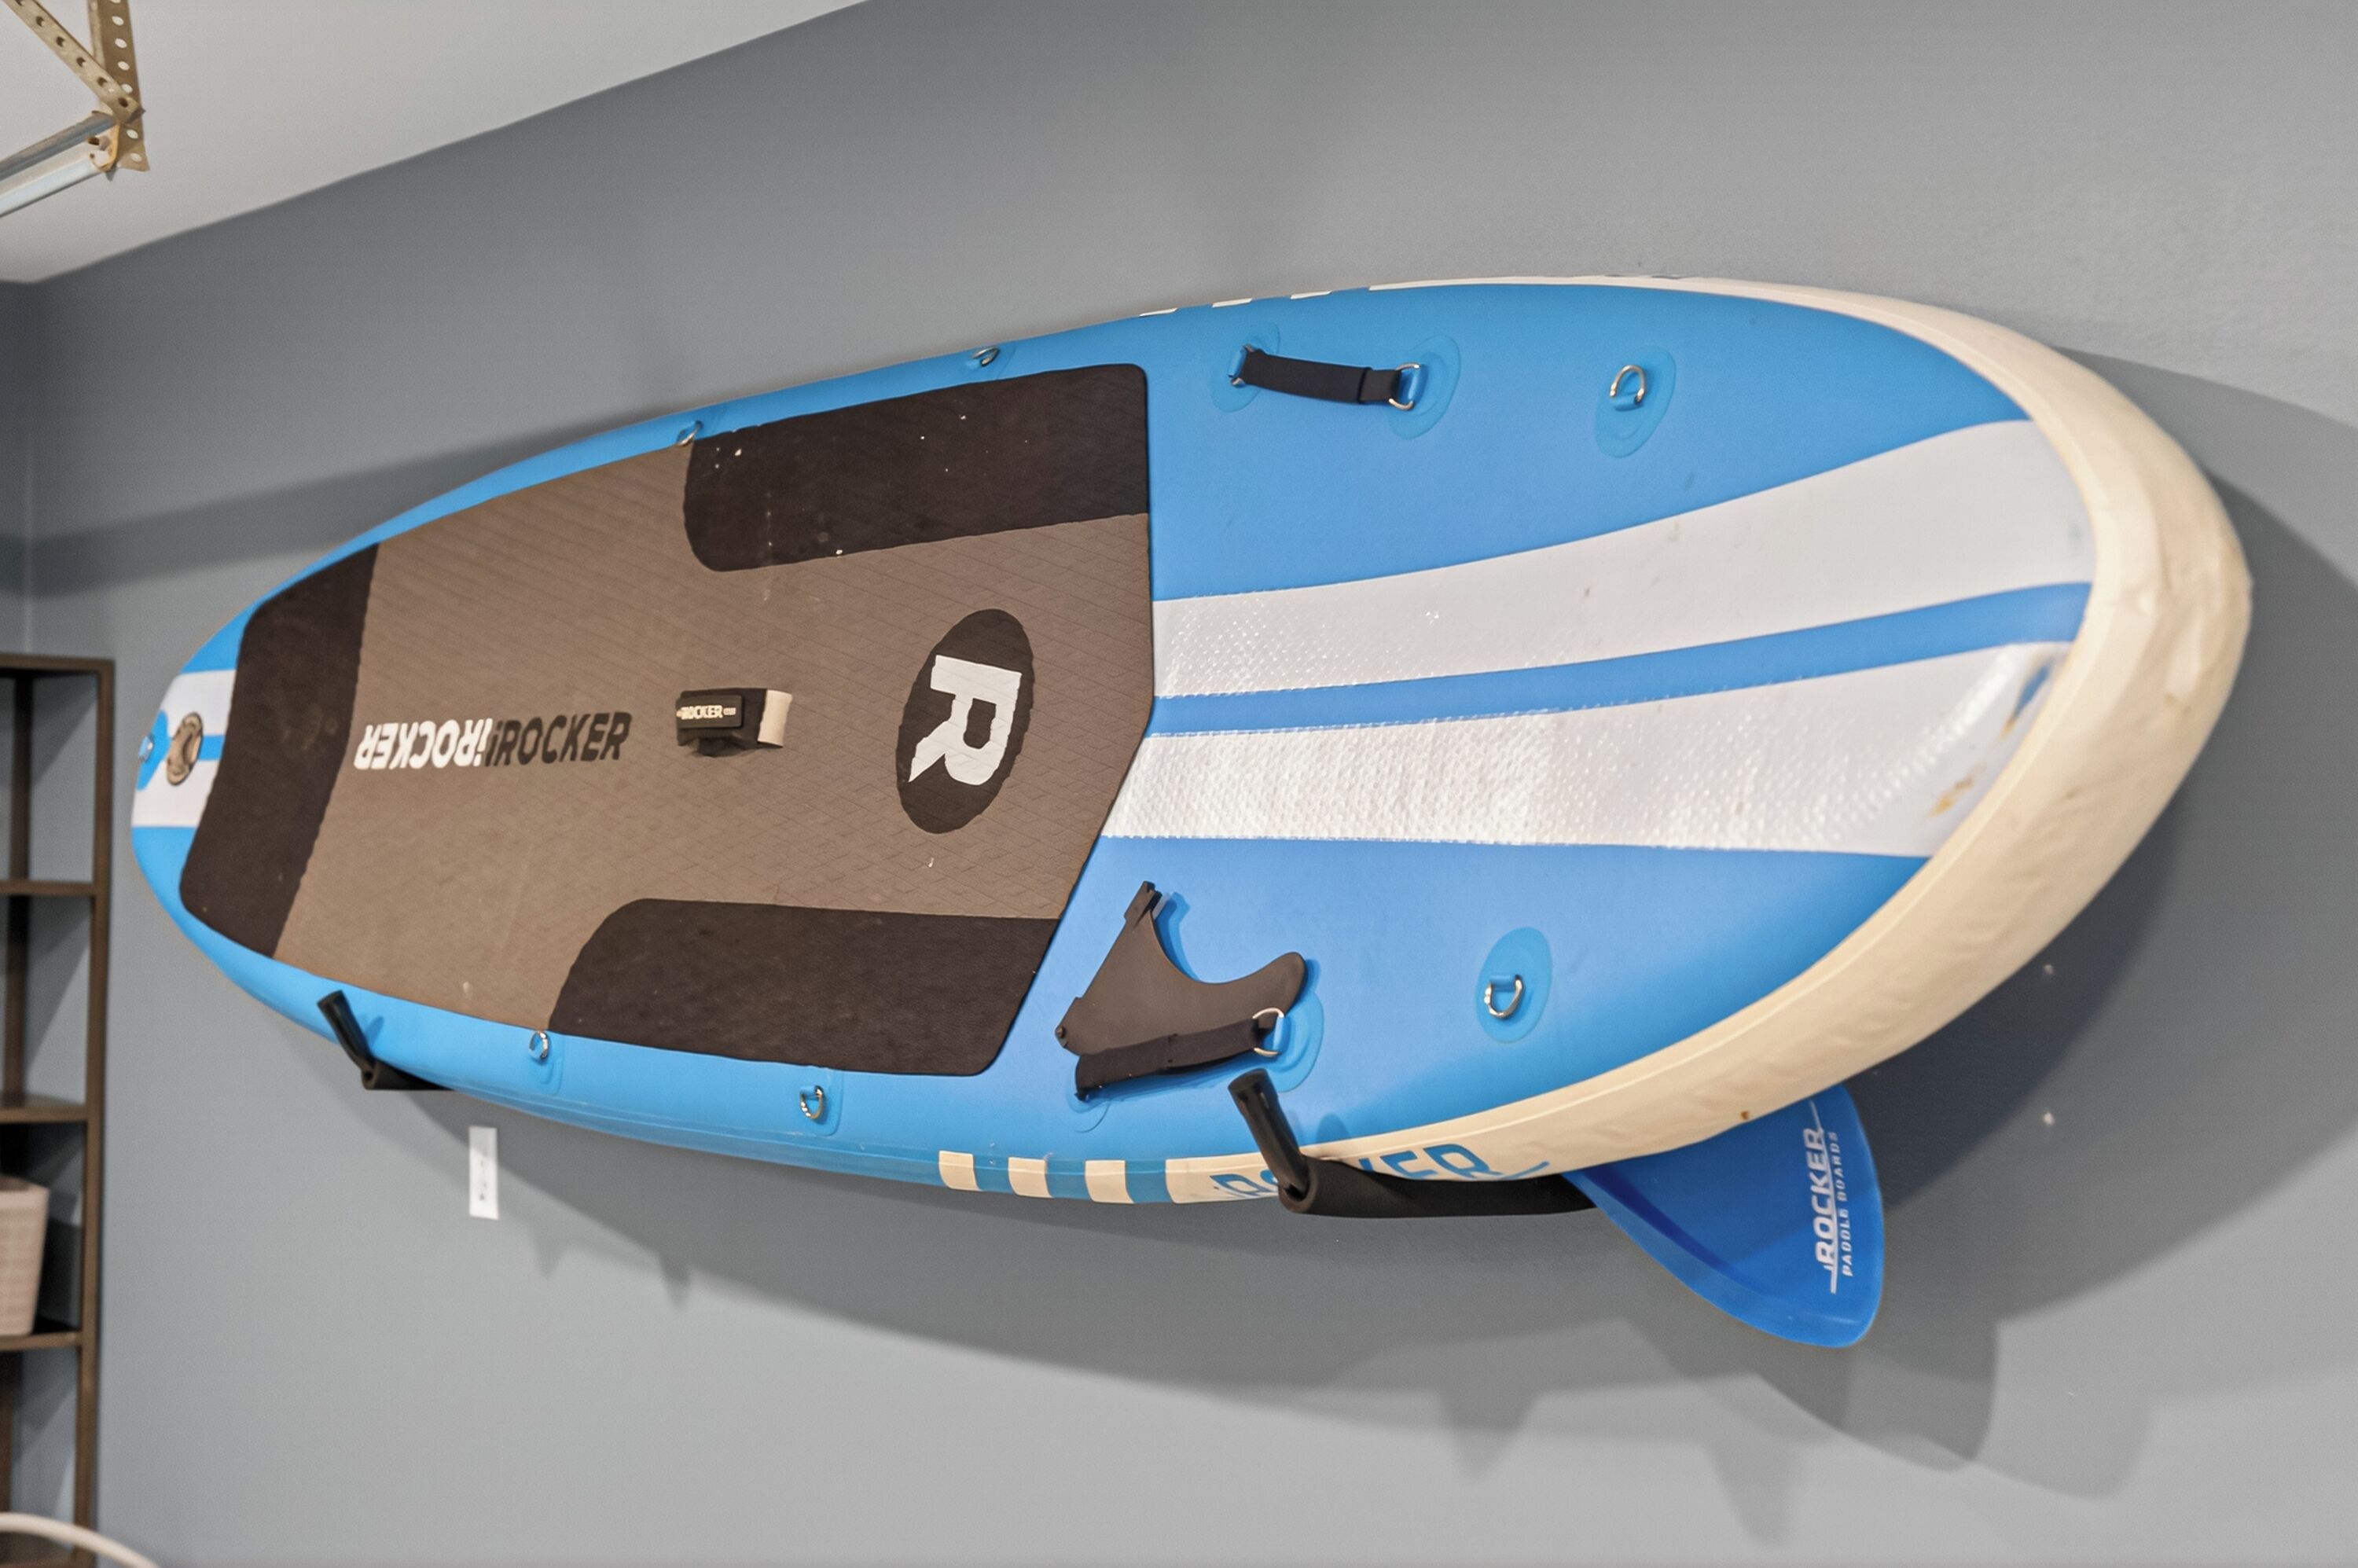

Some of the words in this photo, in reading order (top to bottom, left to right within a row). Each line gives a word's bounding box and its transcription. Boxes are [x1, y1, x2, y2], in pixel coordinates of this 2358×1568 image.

[354, 718, 494, 770] iROCKER
[485, 711, 632, 767] iROCKER
[909, 655, 1022, 786] R
